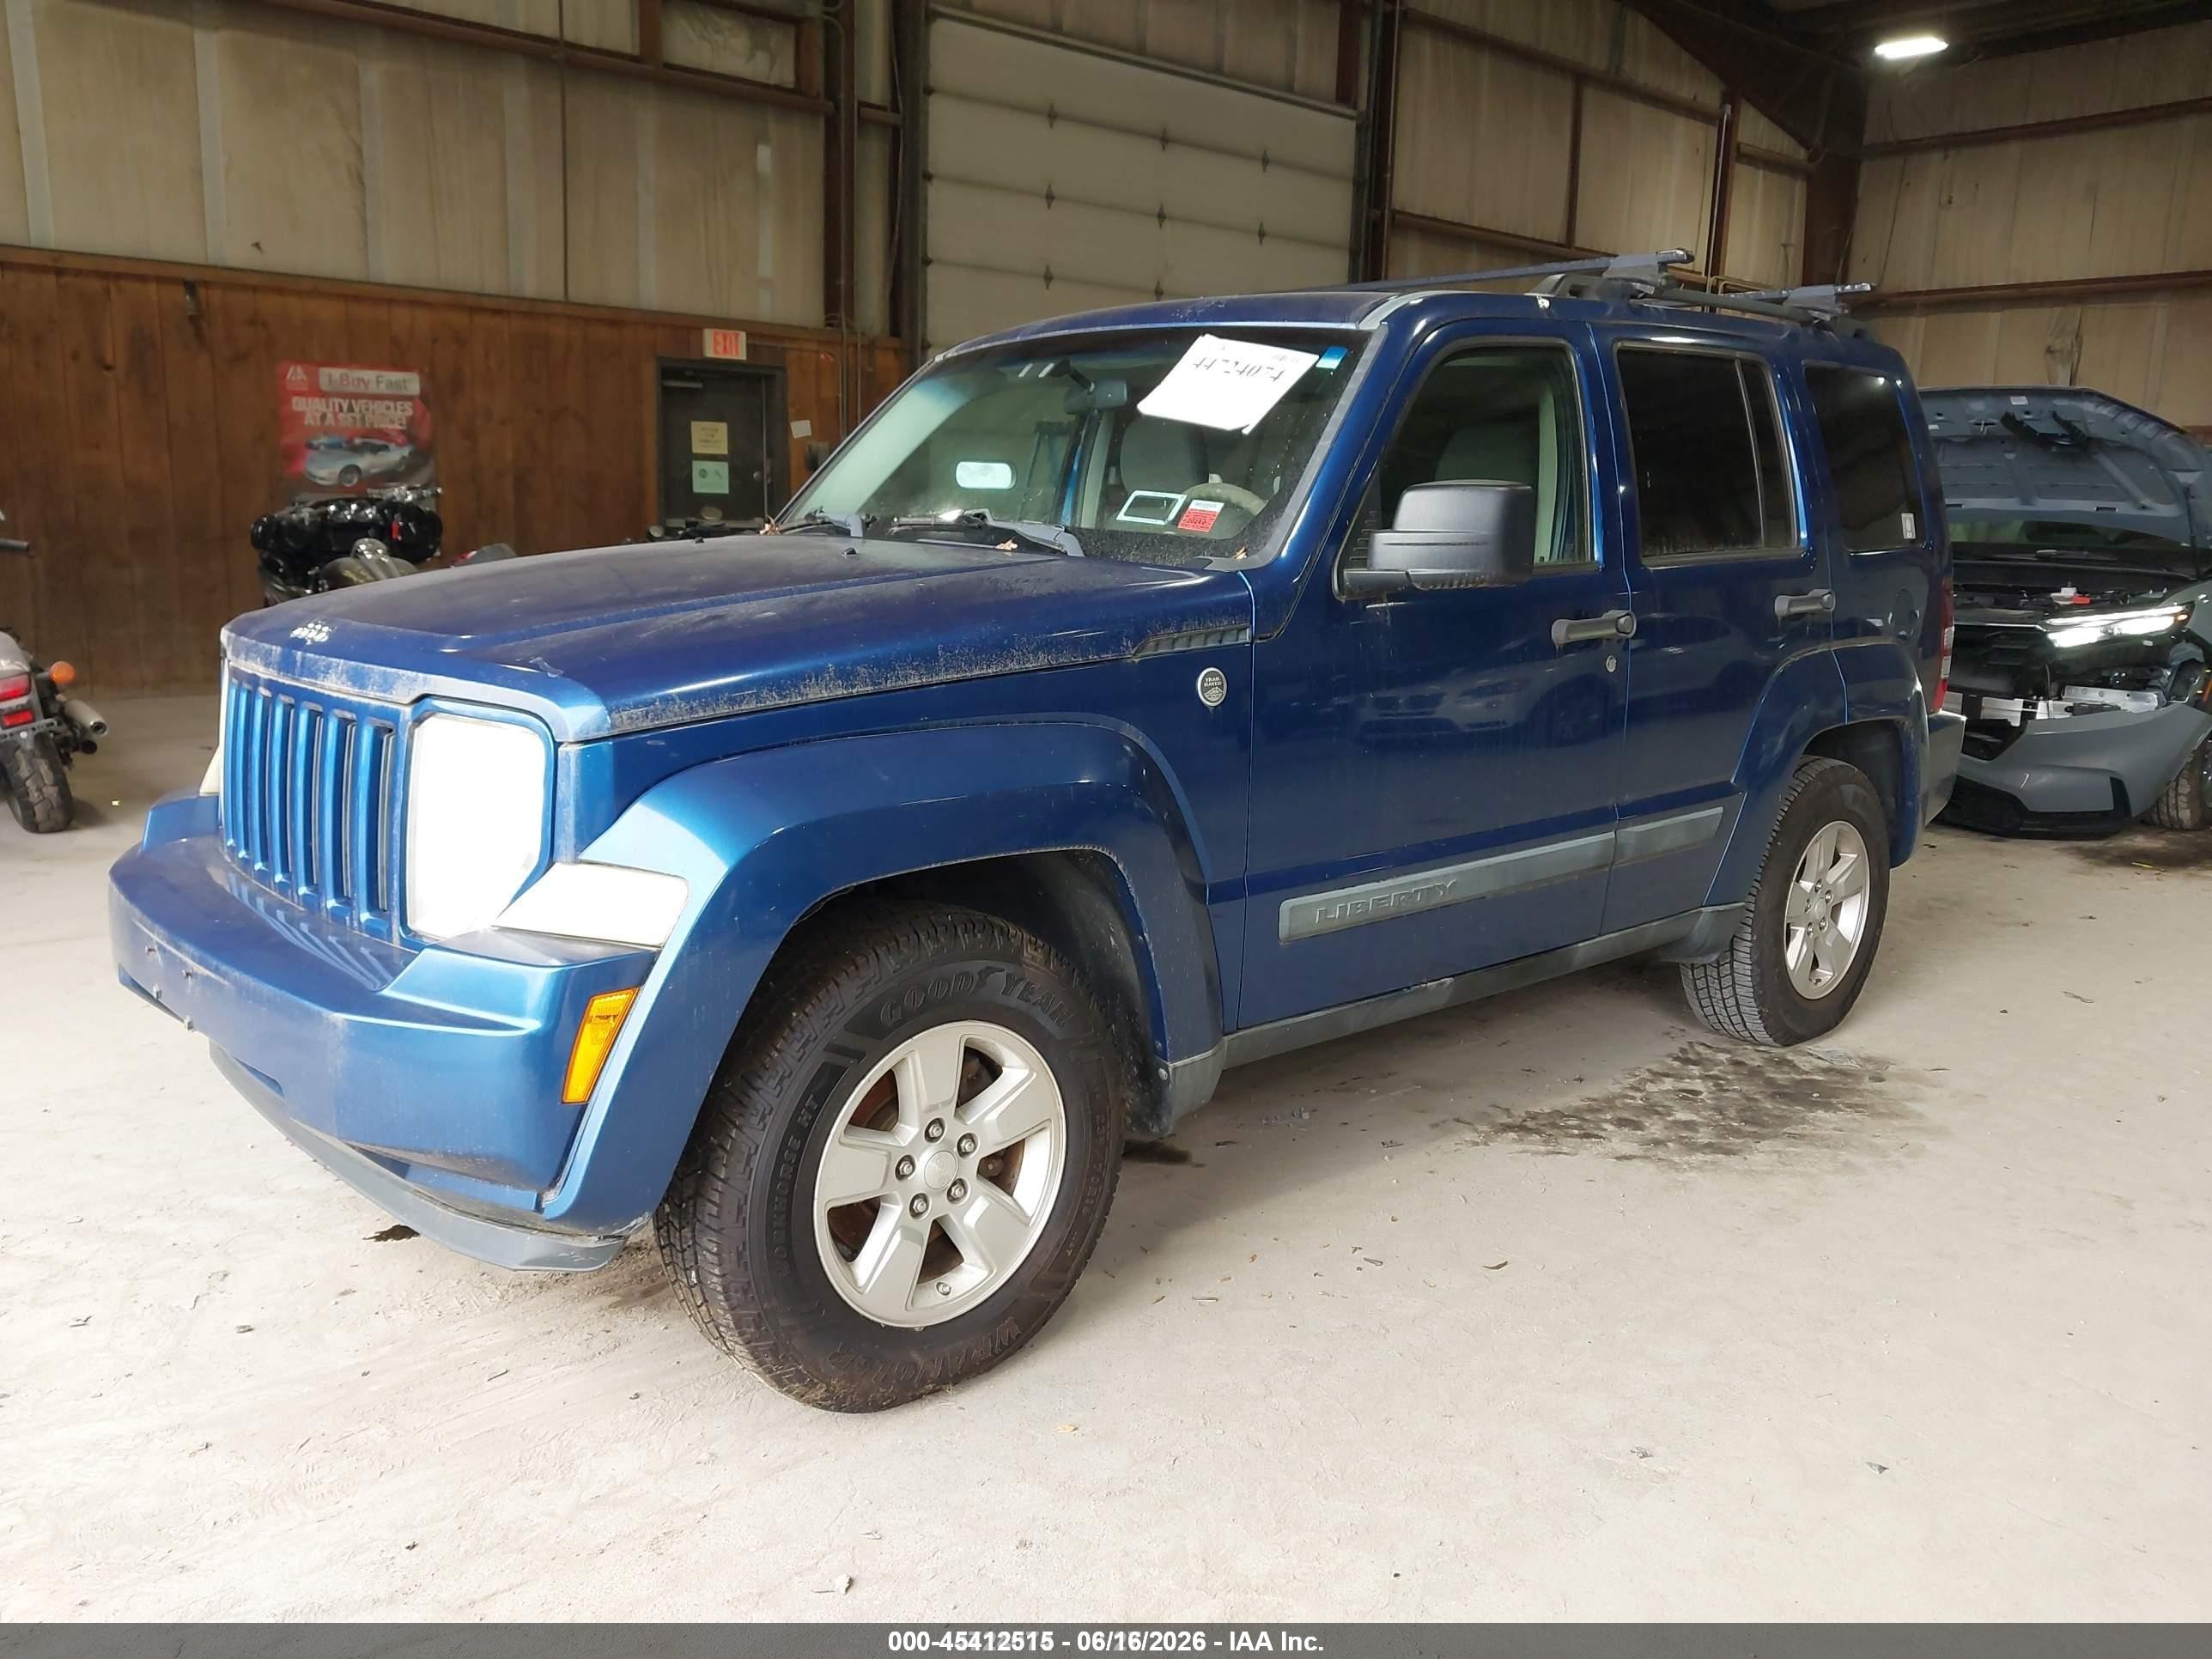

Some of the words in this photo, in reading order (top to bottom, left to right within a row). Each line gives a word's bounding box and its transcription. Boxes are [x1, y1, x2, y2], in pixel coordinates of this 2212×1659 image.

[713, 331, 740, 356] EXIT
[376, 374, 408, 390] Fast
[292, 396, 350, 412] QUALITY
[350, 398, 413, 416] VEHICLES
[1315, 878, 1456, 924] LIBERTY
